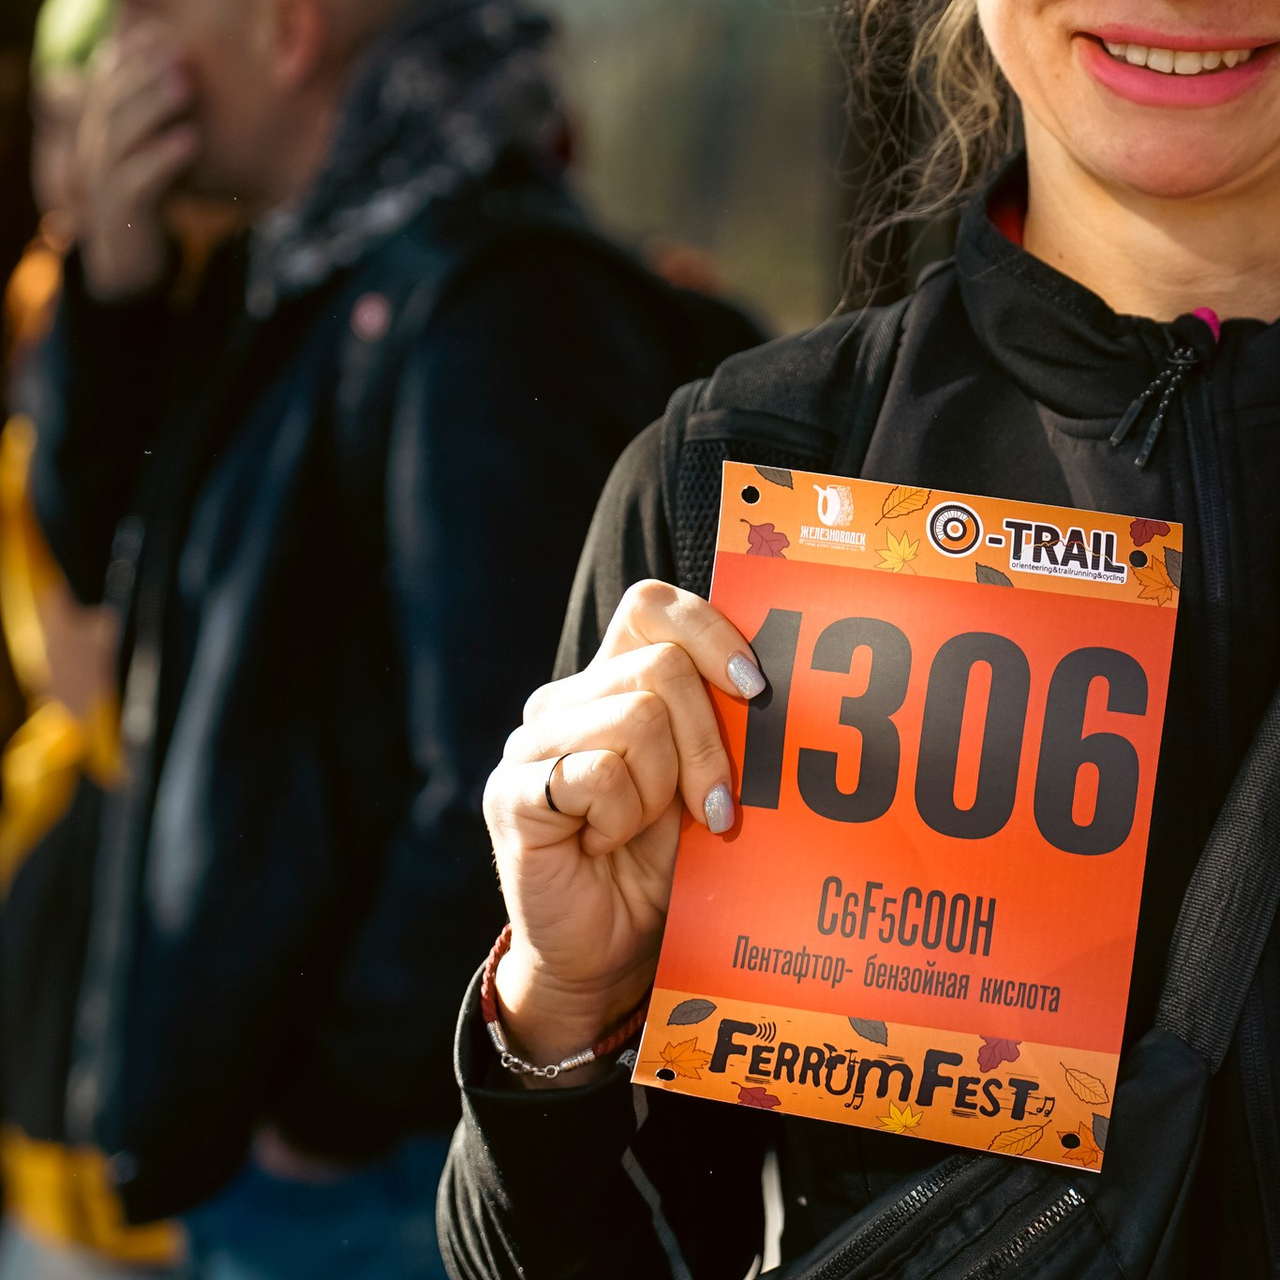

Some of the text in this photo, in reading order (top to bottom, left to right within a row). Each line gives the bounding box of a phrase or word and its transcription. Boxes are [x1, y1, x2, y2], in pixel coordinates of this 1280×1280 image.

[800, 525, 866, 545] ЖЕЛЕЗНОВОДСК
[1011, 561, 1125, 584] orienteering&trailrunning&cycling
[740, 607, 1149, 856] 1306
[817, 875, 997, 956] C6F5COOH
[732, 935, 1061, 1013] Пентафтор- бензойная кислота
